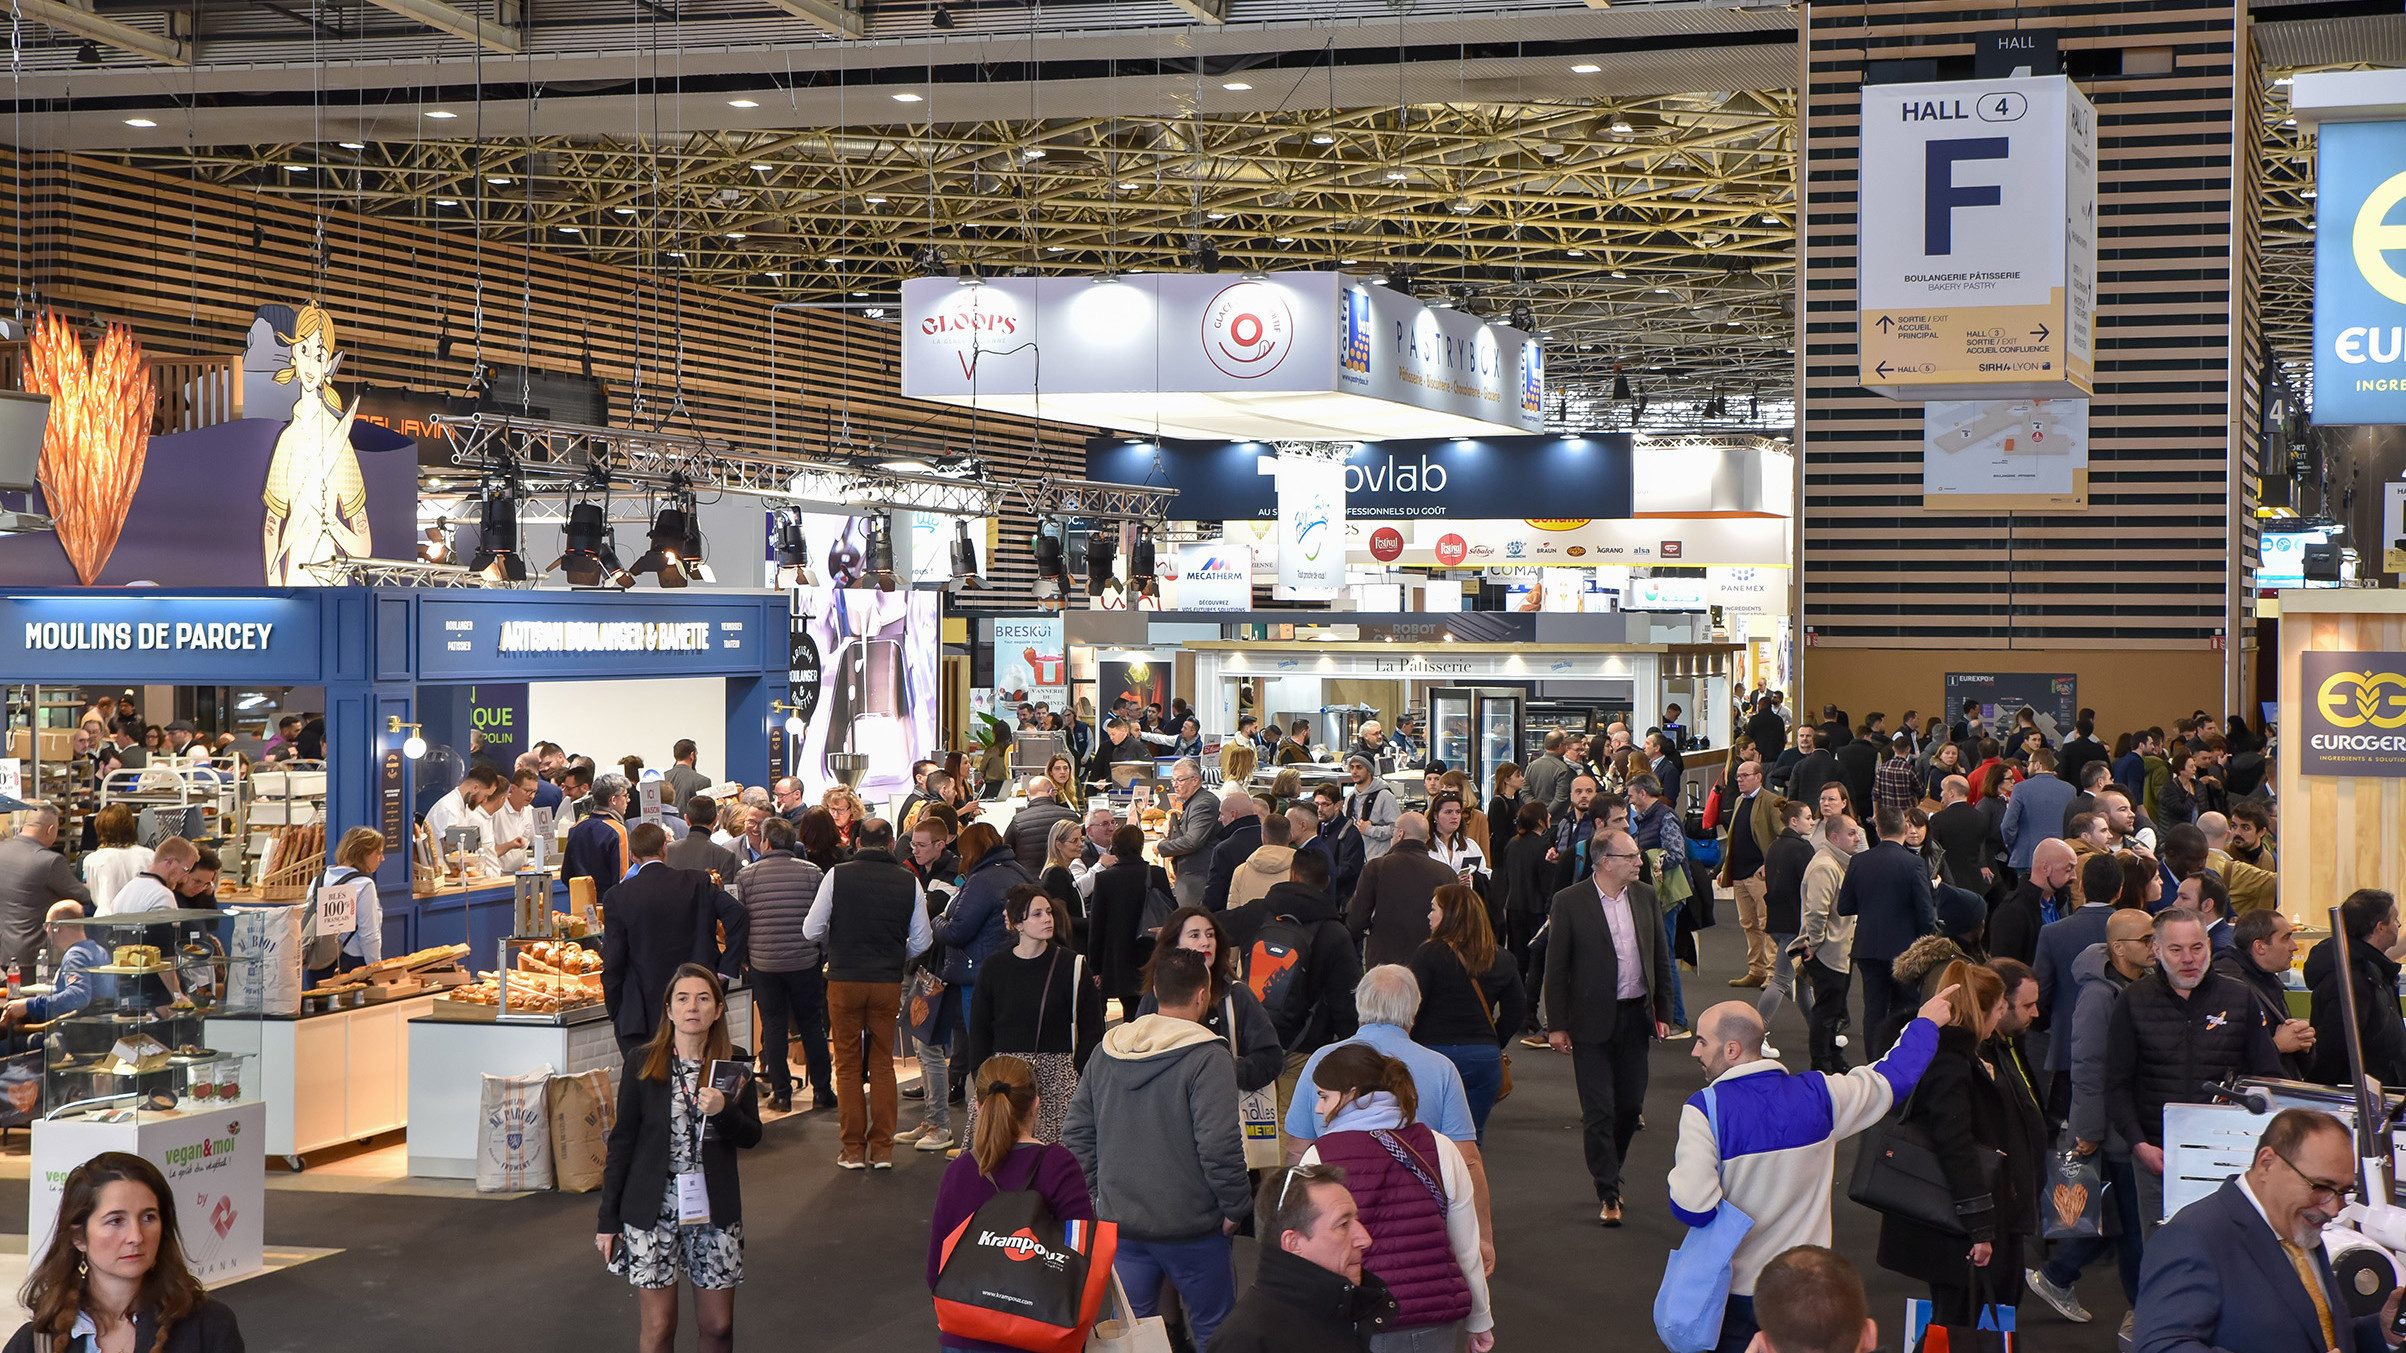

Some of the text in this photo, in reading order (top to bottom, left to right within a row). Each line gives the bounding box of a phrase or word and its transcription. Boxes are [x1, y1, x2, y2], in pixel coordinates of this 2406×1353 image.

[1998, 36, 2036, 49] HALL
[1902, 98, 2009, 121] HALL 4
[1924, 136, 2009, 256] F
[1904, 269, 2021, 283] BOULANGERIE PÂTISSERIE
[1928, 281, 1997, 292] BAKERY PASTRY
[922, 313, 1017, 335] GLOOPS
[1898, 316, 1927, 324] SORTIE
[1994, 329, 2000, 337] 3
[1966, 338, 1995, 346] SORTIE
[1999, 345, 2050, 353] CONFLUENCE
[2013, 361, 2039, 371] LYON
[2269, 399, 2285, 427] 4
[1258, 508, 1271, 516] AU
[1406, 507, 1419, 516] DU
[1421, 505, 1447, 516] GOÛT
[1375, 537, 1398, 549] Festival
[1597, 546, 1624, 554] AGRANO
[1634, 546, 1650, 554] alsa
[1186, 572, 1243, 580] MECATHERM
[1392, 624, 1436, 634] ROBOT
[25, 622, 274, 650] MOULINS DE PARCEY
[501, 621, 564, 651] ARTISAN
[658, 622, 710, 650] BANETTE
[791, 645, 814, 664] ARTISAN
[1374, 657, 1472, 673] La Pâtisserie
[1246, 1125, 1276, 1136] METRO
[165, 1137, 235, 1167] vegan&moi
[197, 1192, 208, 1208] by
[982, 1290, 1034, 1306] www.krampouz.com
